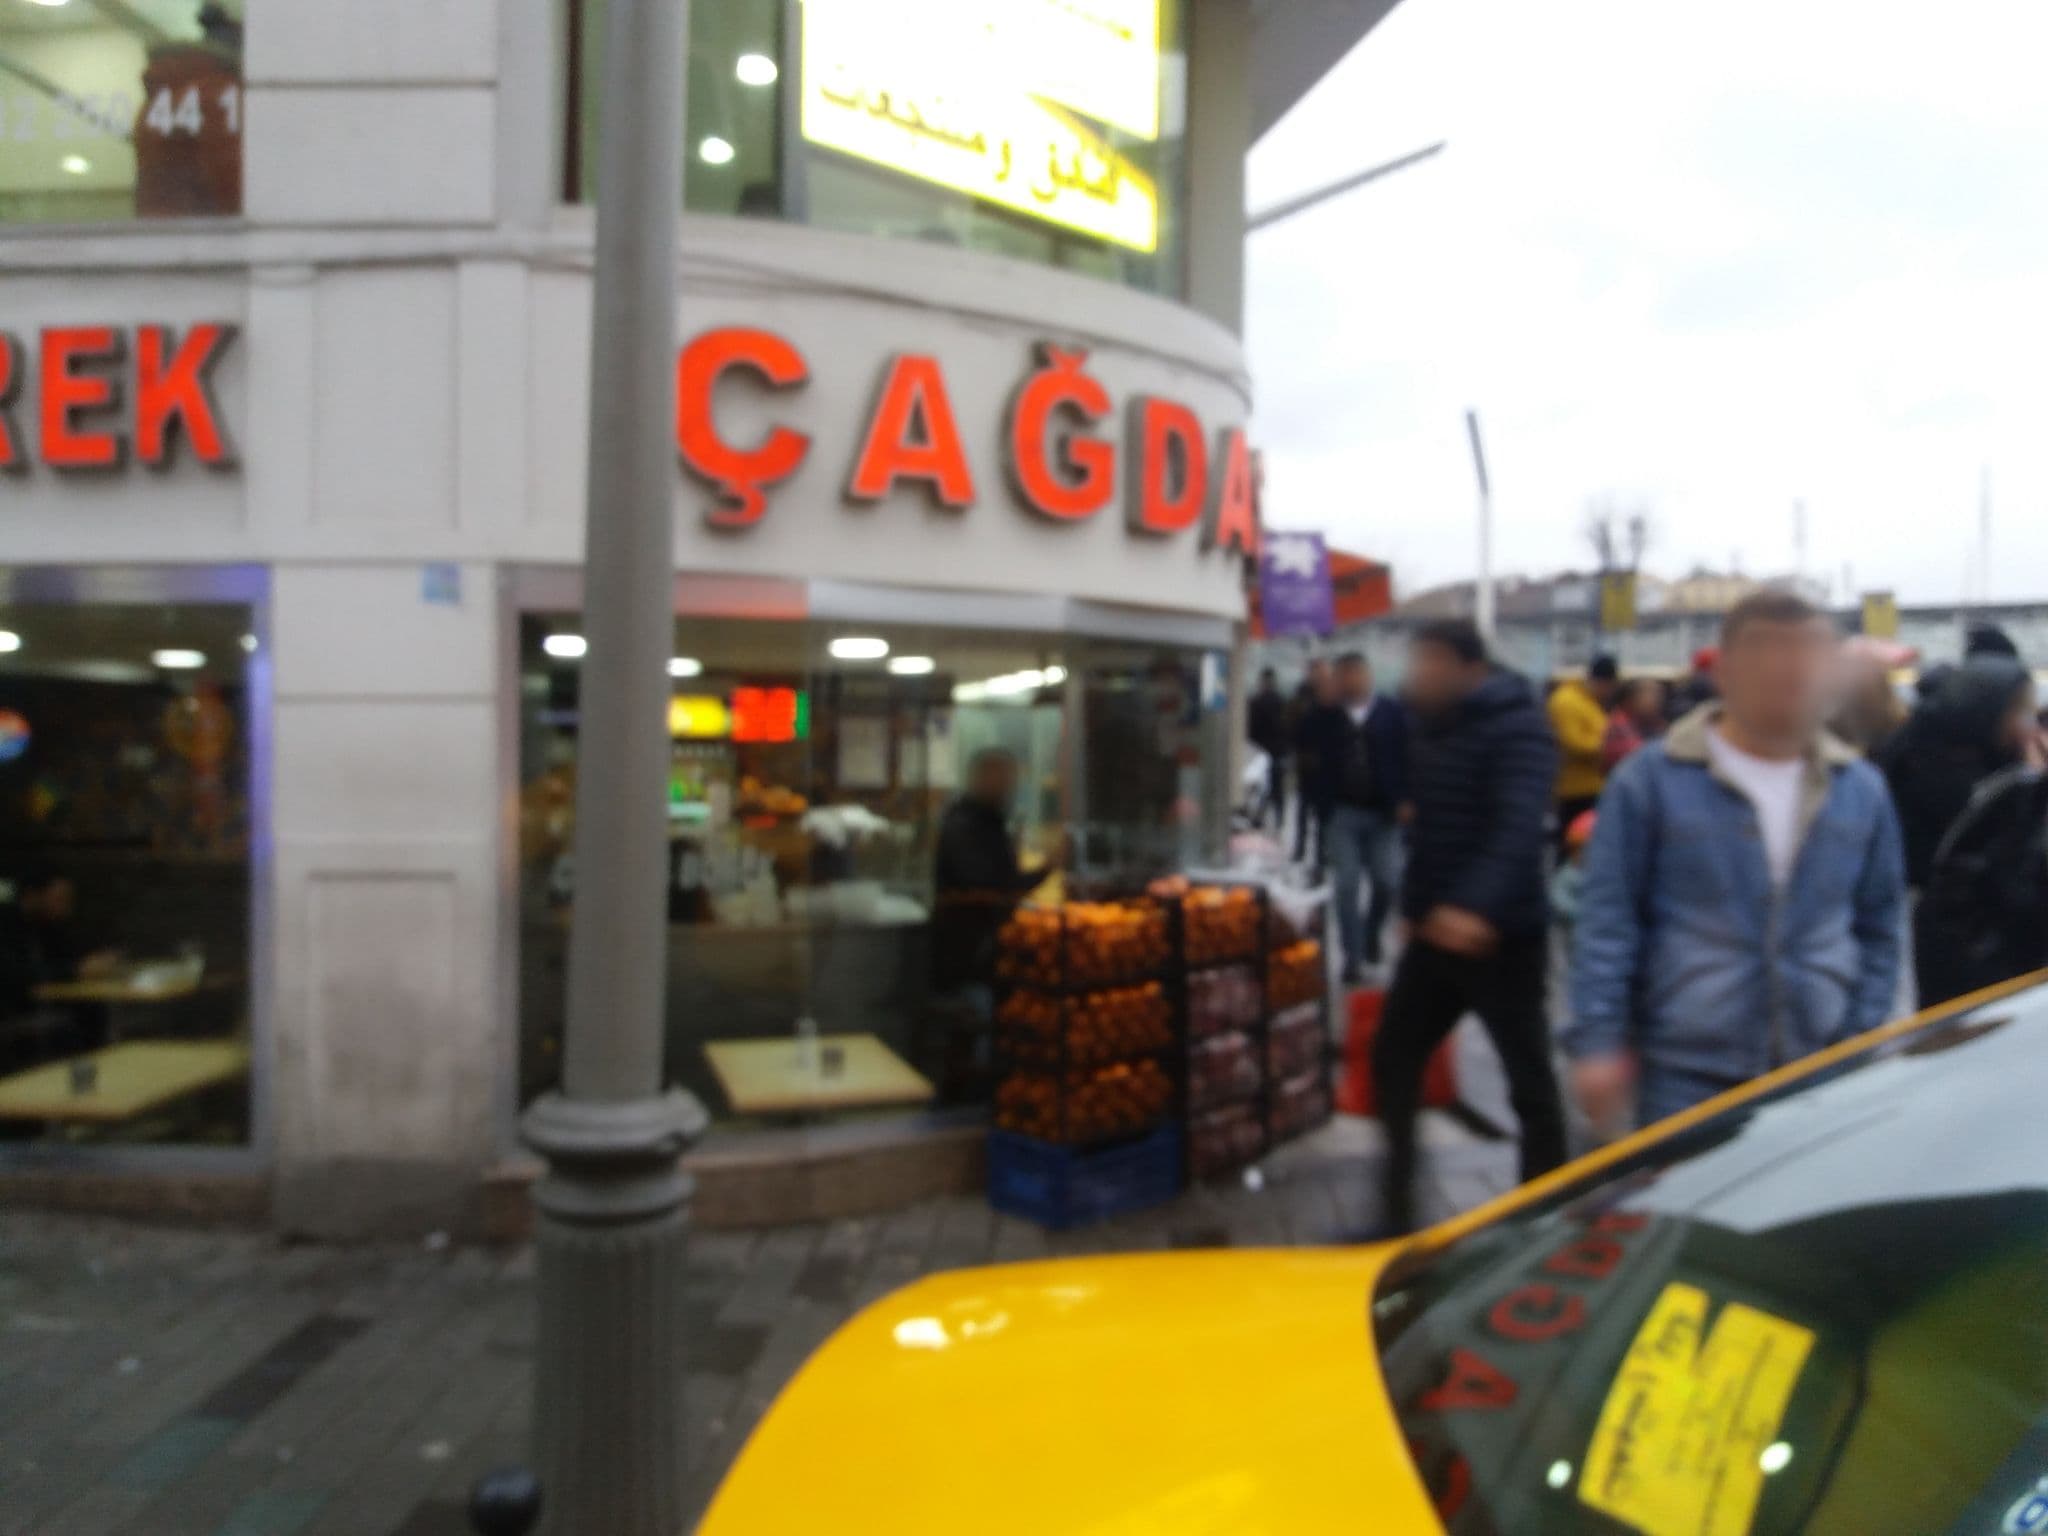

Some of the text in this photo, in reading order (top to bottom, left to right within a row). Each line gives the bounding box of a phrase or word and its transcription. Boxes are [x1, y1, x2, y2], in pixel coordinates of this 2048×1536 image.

[146, 87, 204, 139] 44
[0, 322, 228, 466] EK
[674, 326, 1263, 562] ÇAĞDA
